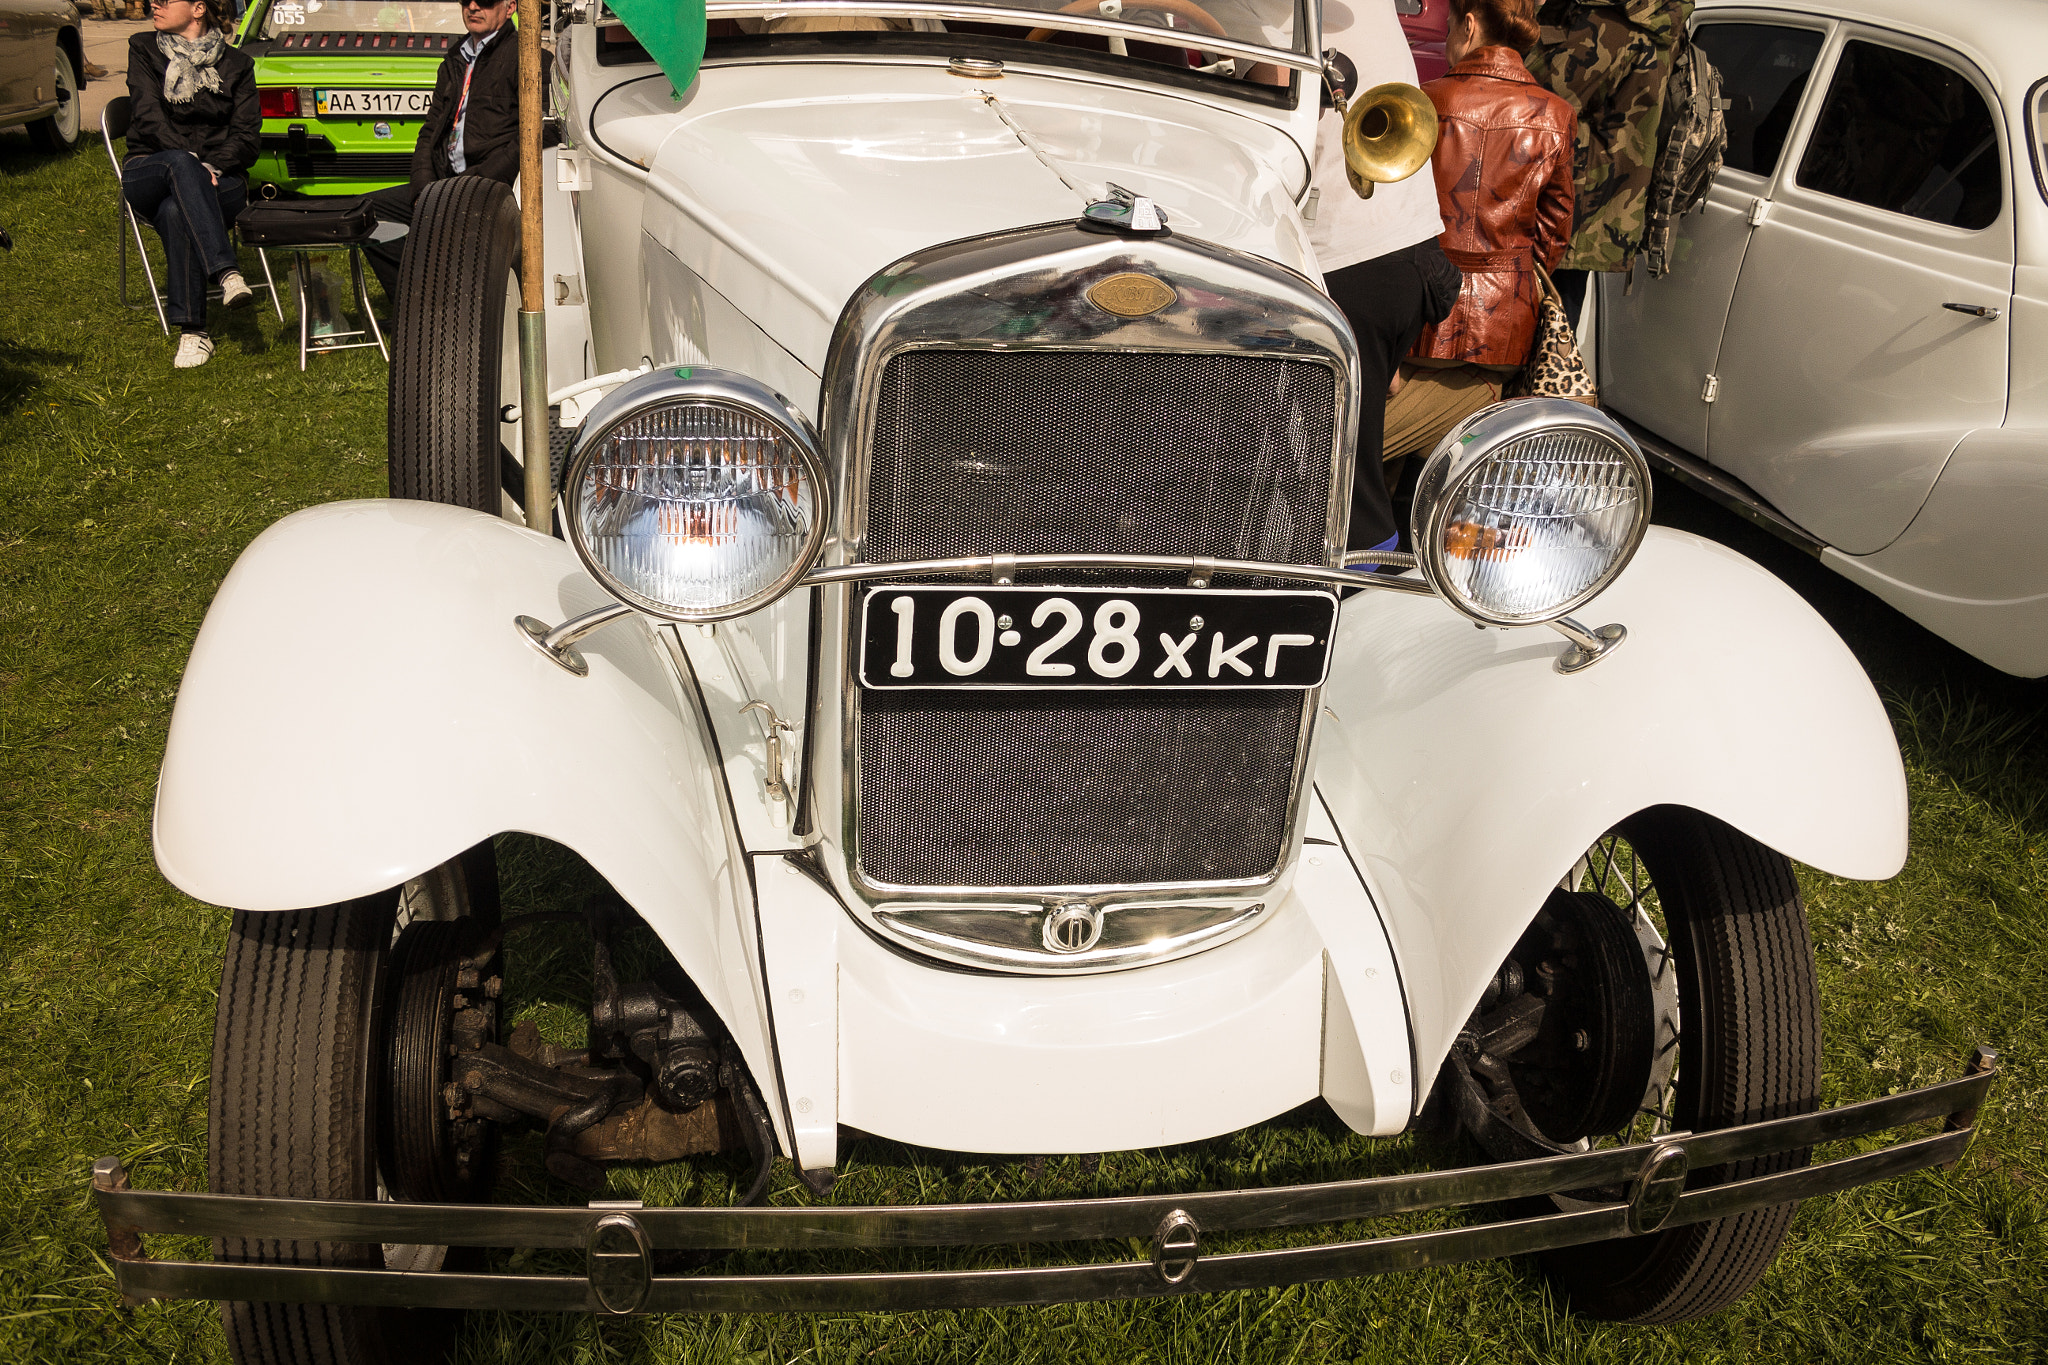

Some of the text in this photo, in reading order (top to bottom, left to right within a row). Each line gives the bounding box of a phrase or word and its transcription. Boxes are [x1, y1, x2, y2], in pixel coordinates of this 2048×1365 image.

[274, 11, 305, 25] 055
[330, 94, 432, 111] AA 3117 CA
